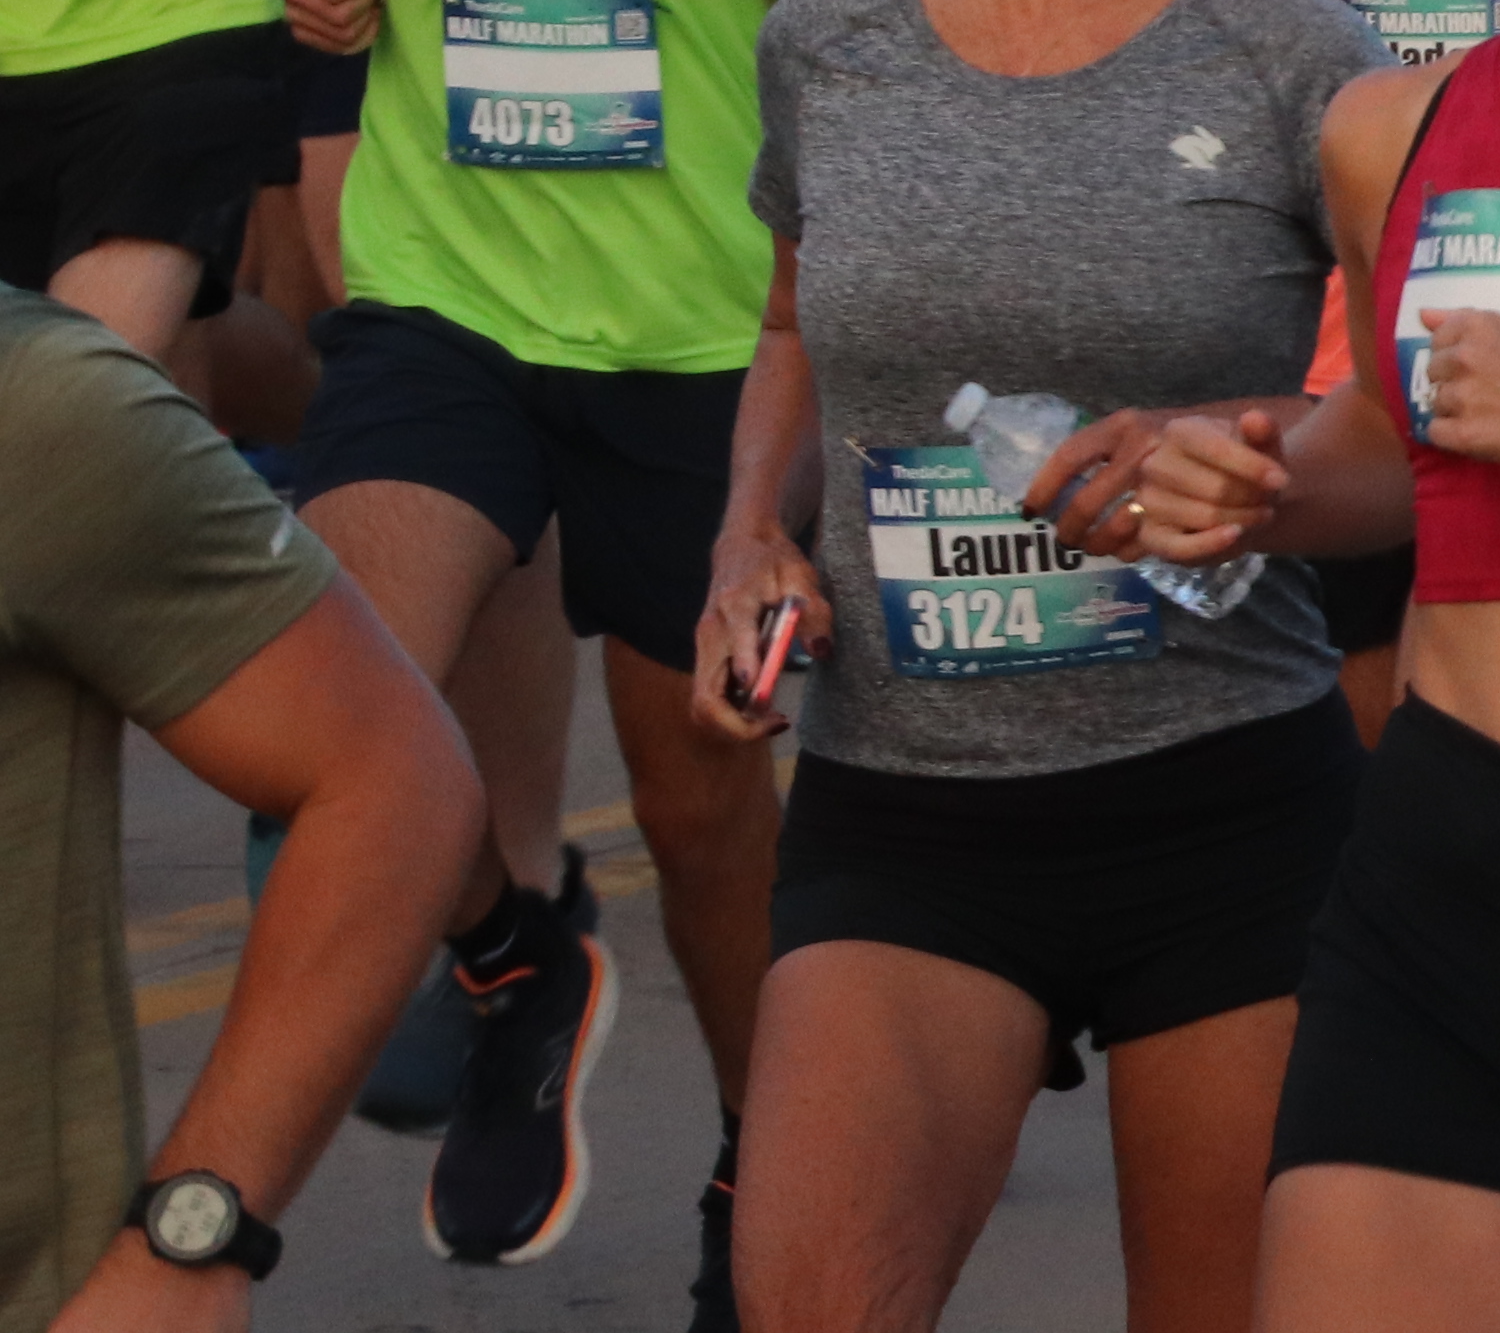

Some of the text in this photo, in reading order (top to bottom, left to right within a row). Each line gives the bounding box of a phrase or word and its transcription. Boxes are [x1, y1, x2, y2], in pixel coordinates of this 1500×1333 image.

[446, 15, 610, 46] HALF MARATHON
[1379, 11, 1488, 35] MARATHON
[469, 97, 576, 148] 4073
[870, 487, 931, 518] HALF
[927, 523, 1084, 579] Laurie
[907, 587, 1045, 651] 3124
